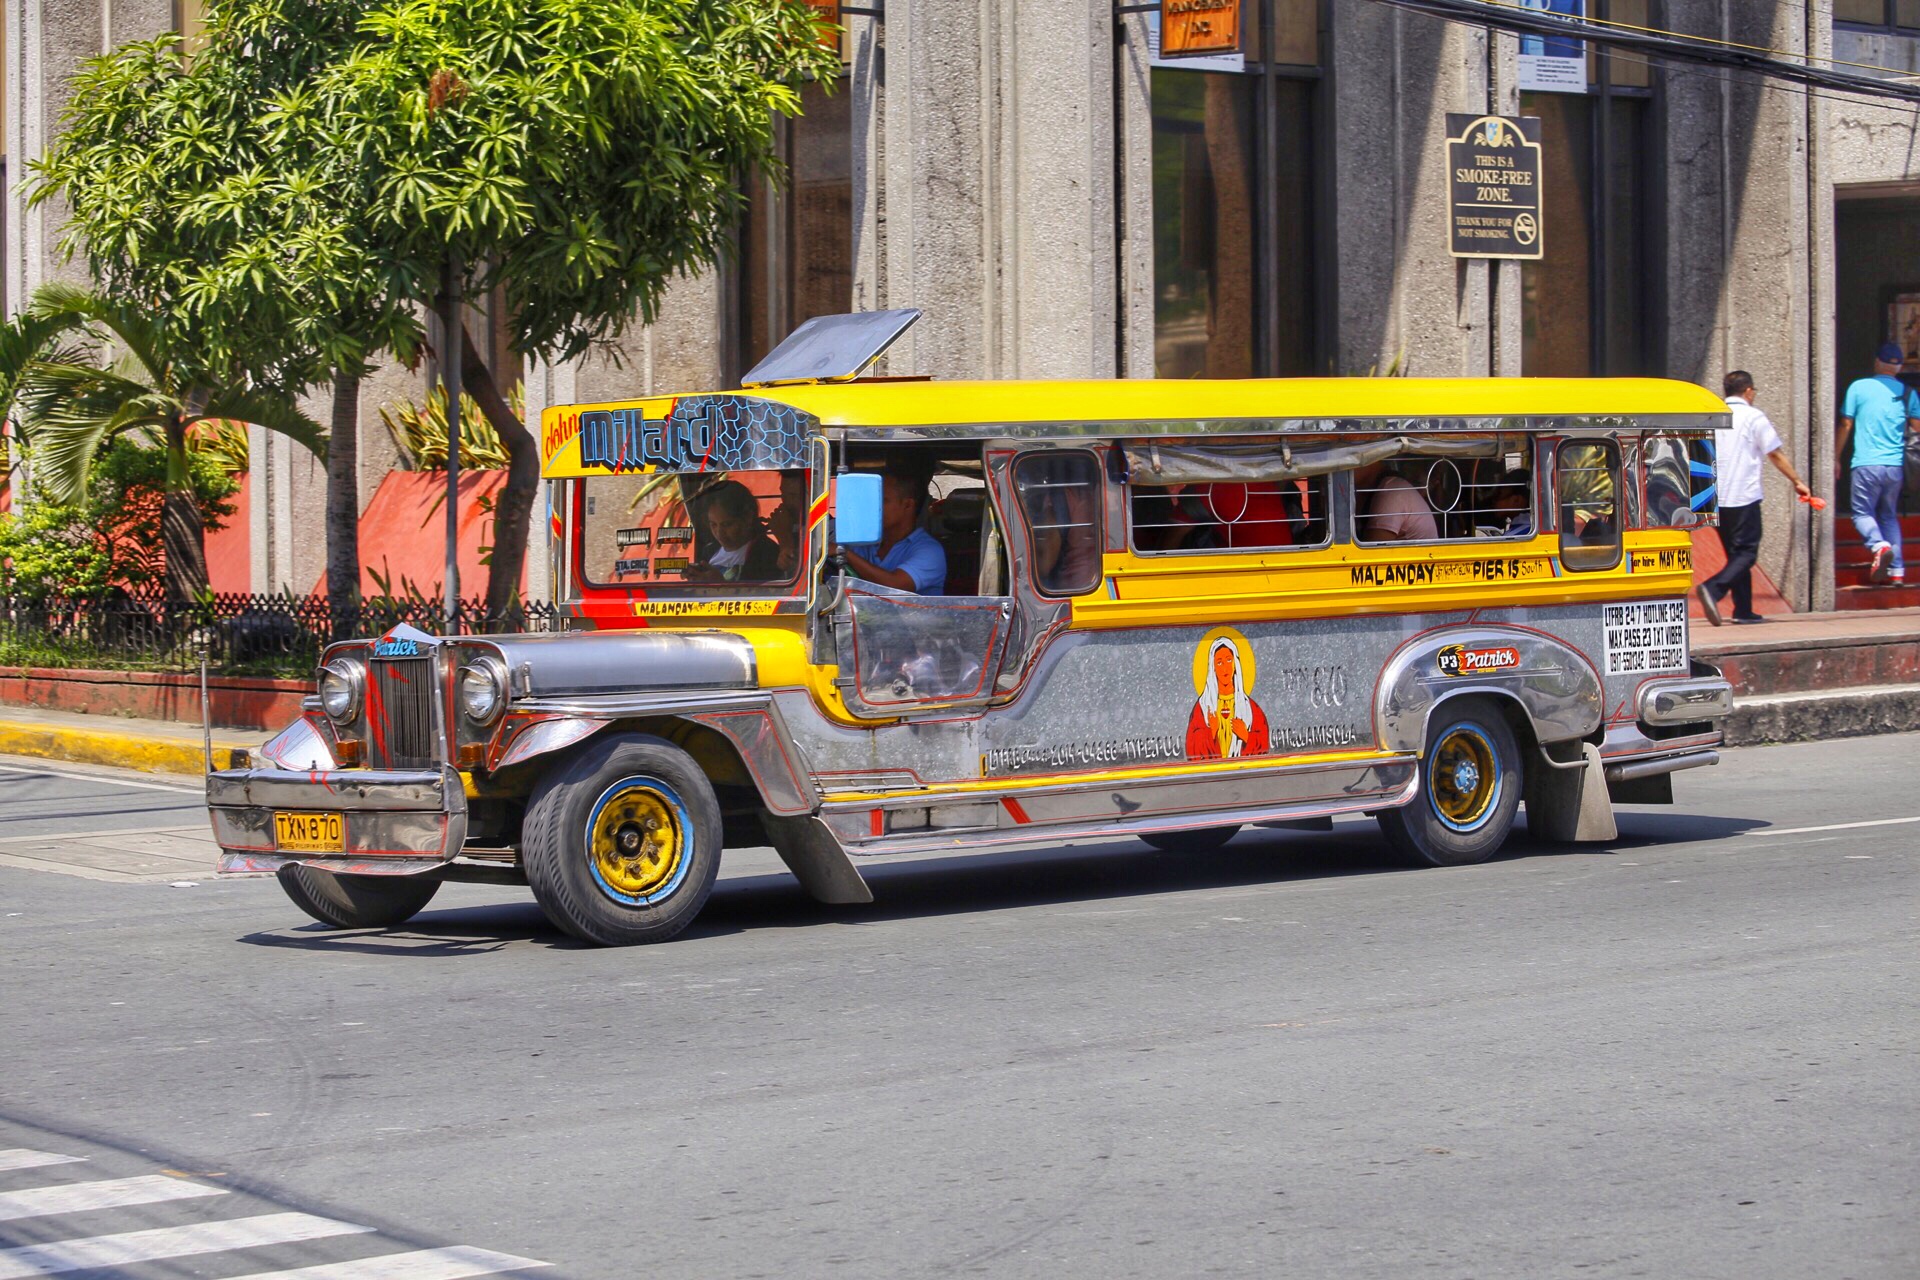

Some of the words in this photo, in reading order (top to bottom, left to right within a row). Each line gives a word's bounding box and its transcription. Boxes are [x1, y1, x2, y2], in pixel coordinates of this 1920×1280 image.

[1474, 155, 1496, 167] THIS
[1498, 156, 1506, 167] IS
[1507, 157, 1514, 168] A
[1456, 168, 1533, 186] SMOKE-FREE
[1476, 187, 1513, 202] ZONE.
[1455, 216, 1481, 226] THANK
[1481, 217, 1496, 227] YOU
[1498, 218, 1513, 228] FOR
[1458, 228, 1474, 238] NOT
[615, 560, 630, 571] STA.
[631, 559, 649, 570] CRUZ
[1642, 556, 1655, 567] hire
[1659, 550, 1675, 570] MAY
[1351, 562, 1435, 586] MALANDAY
[1473, 559, 1503, 580] PIER
[1508, 559, 1519, 579] 15
[1521, 560, 1543, 576] South
[640, 601, 693, 616] MALANDAY
[717, 601, 740, 615] PIER
[743, 602, 751, 614] 15
[753, 602, 772, 613] South
[1604, 606, 1624, 627] LTFRB
[1643, 604, 1668, 624] HOTLINE
[1669, 603, 1684, 623] 1342
[1653, 626, 1664, 646] TXT
[1665, 625, 1683, 646] VIBER
[374, 636, 419, 657] Patrick
[1440, 655, 1458, 669] P3
[1465, 650, 1515, 668] Patrick
